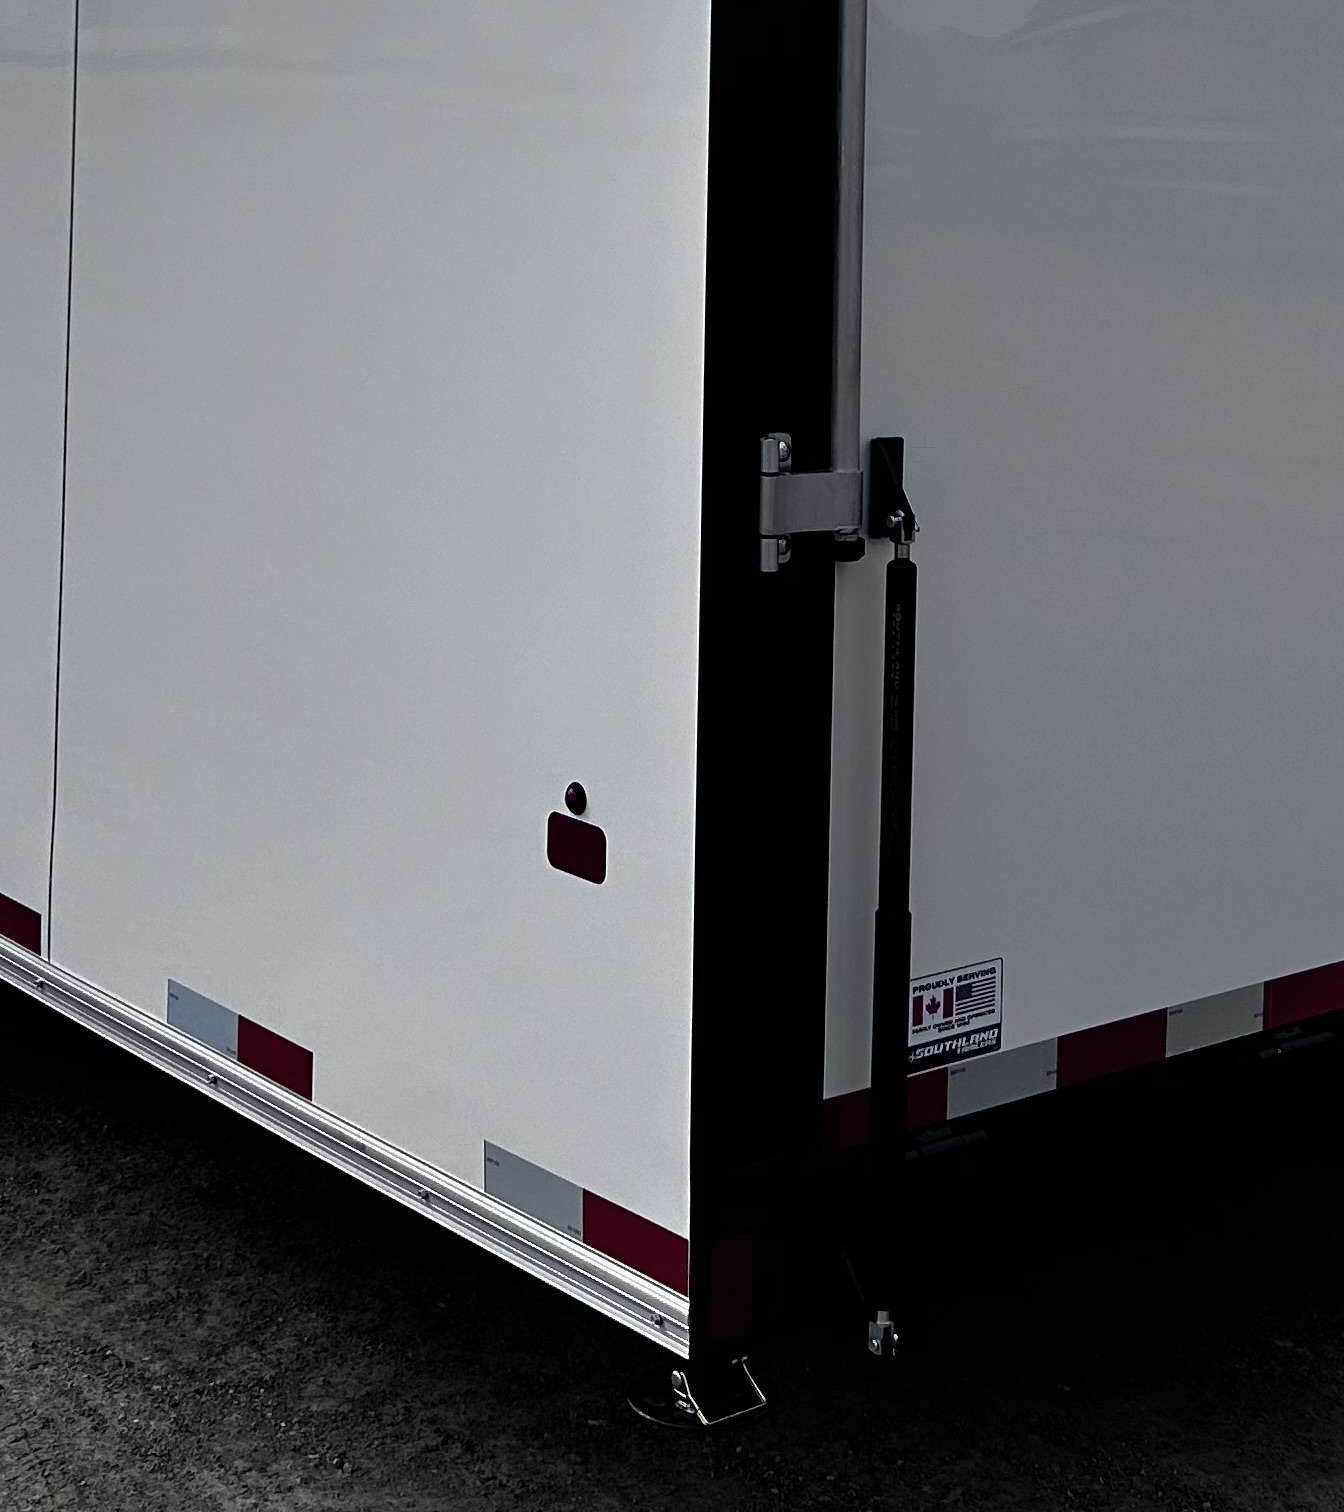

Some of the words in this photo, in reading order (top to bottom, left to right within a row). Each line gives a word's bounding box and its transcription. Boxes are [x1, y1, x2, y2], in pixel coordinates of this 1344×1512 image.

[912, 977, 955, 994] PROUDLY
[956, 967, 996, 983] SERVING
[914, 1029, 999, 1059] SOUTHLAND
